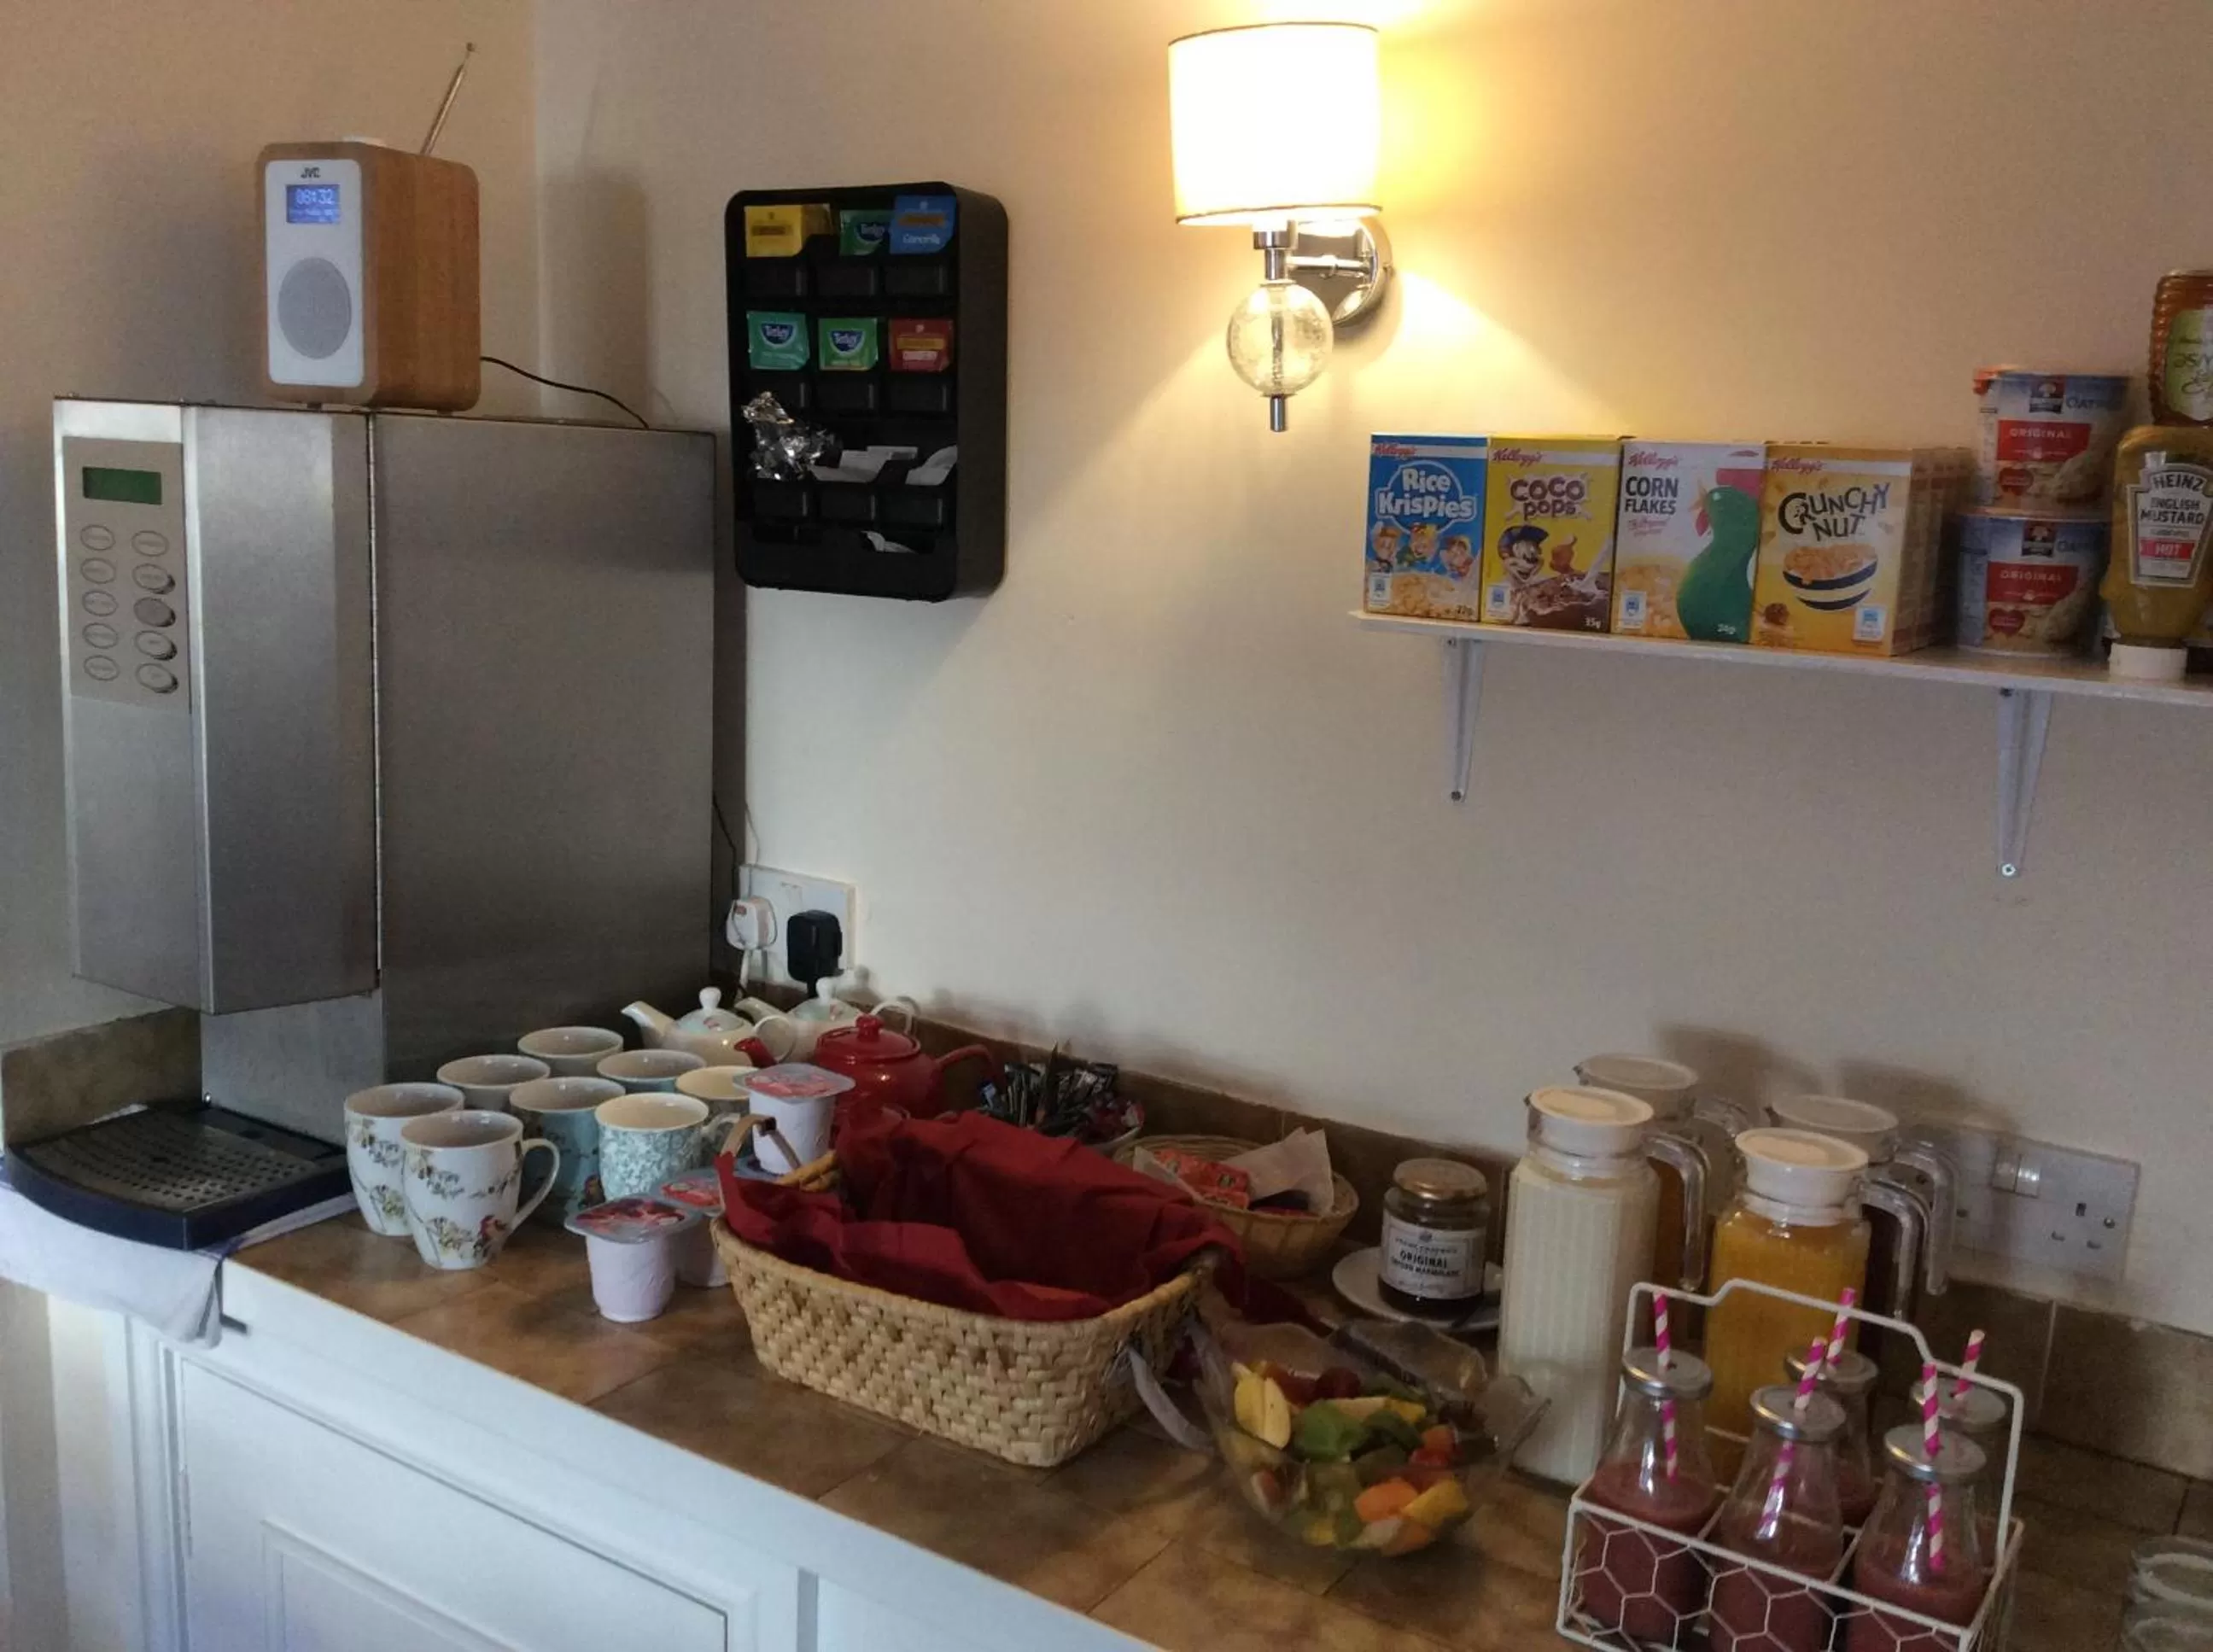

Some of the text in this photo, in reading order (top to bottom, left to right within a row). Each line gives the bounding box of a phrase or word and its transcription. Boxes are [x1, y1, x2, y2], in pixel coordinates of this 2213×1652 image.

[301, 167, 321, 178] JVC
[2009, 428, 2072, 439] ORIGINAL
[1492, 448, 1543, 466] Kellogg's
[1402, 468, 1451, 494] Rice
[1625, 476, 1679, 499] CORN
[2152, 474, 2204, 492] HEINZ
[1378, 492, 1474, 517] Krispies
[1624, 498, 1677, 515] FLAKES
[1778, 482, 1891, 535] CRUNCHY
[2150, 497, 2200, 511] ENGLISH
[2140, 510, 2204, 525] MUSTARD
[1812, 512, 1866, 542] NUT
[2155, 543, 2182, 556] HOT
[2000, 569, 2062, 581] ORIGINAL
[1400, 1249, 1447, 1269] ORIGINAL
